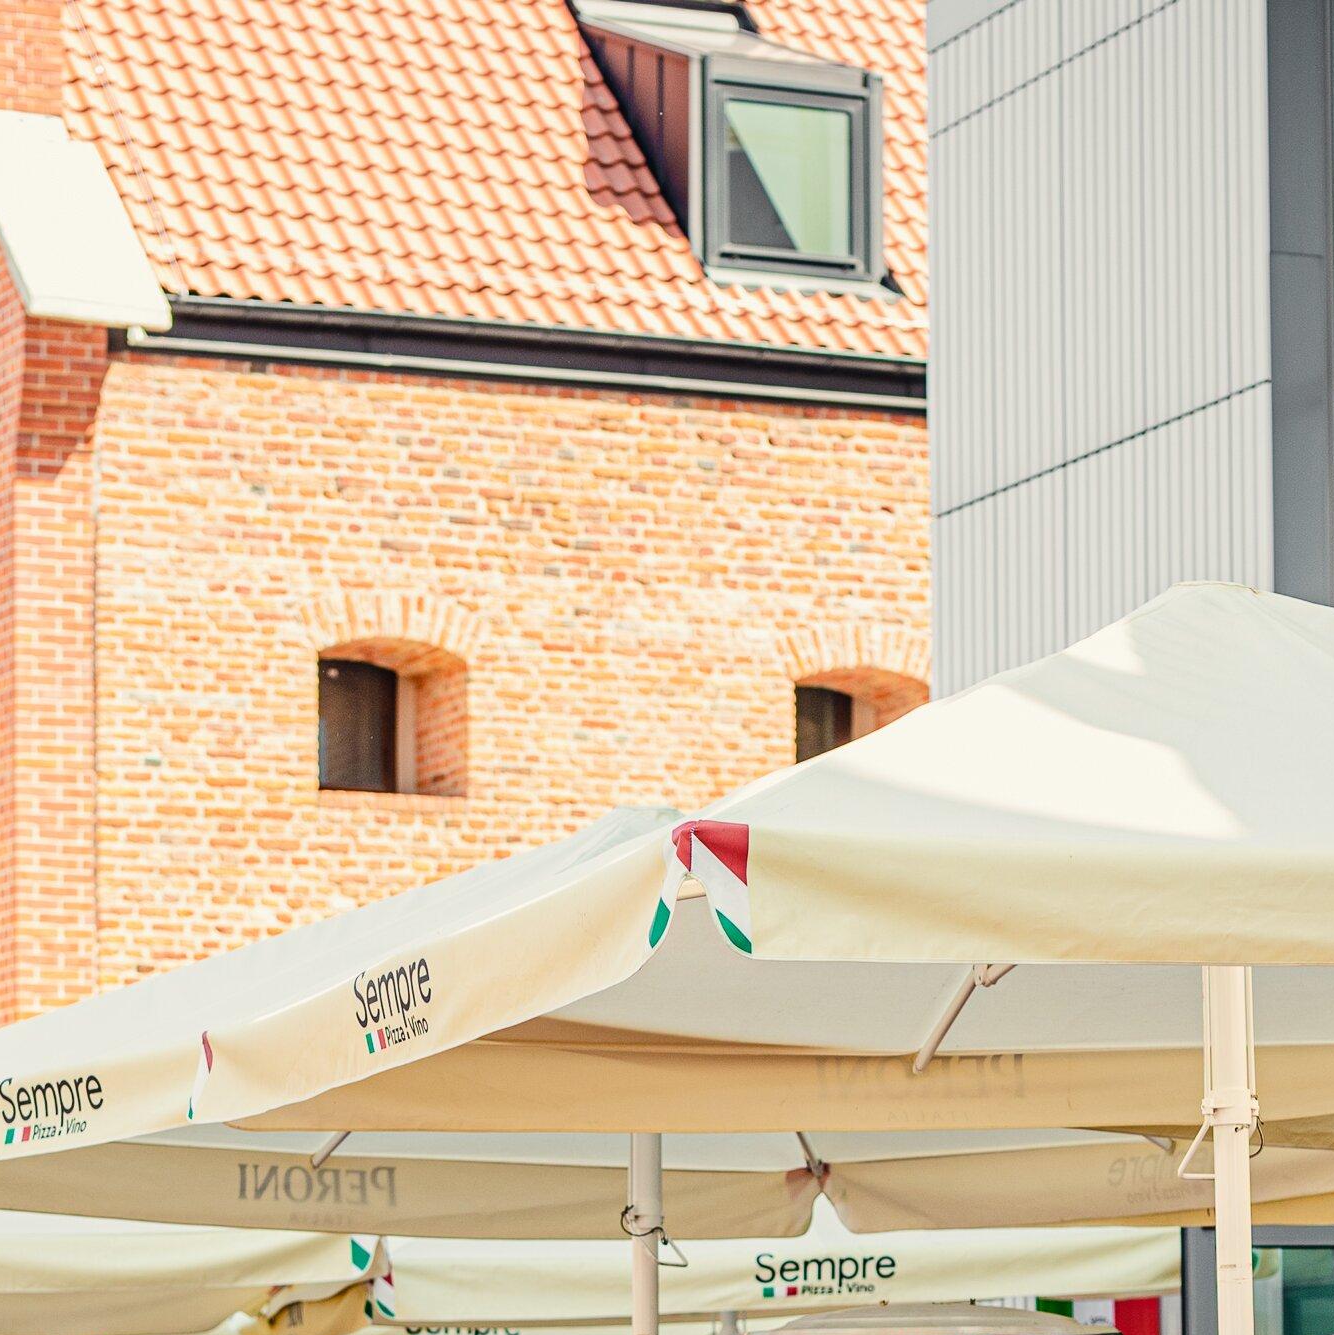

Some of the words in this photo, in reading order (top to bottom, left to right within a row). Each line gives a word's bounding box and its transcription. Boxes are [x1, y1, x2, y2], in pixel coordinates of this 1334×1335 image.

[353, 958, 432, 1029] Sempre
[384, 1024, 407, 1047] Pizza
[407, 1015, 429, 1038] Vino
[31, 1124, 57, 1141] Pizza
[65, 1117, 88, 1135] Vino
[755, 1252, 896, 1288] Sempre
[845, 1281, 876, 1294] Vino
